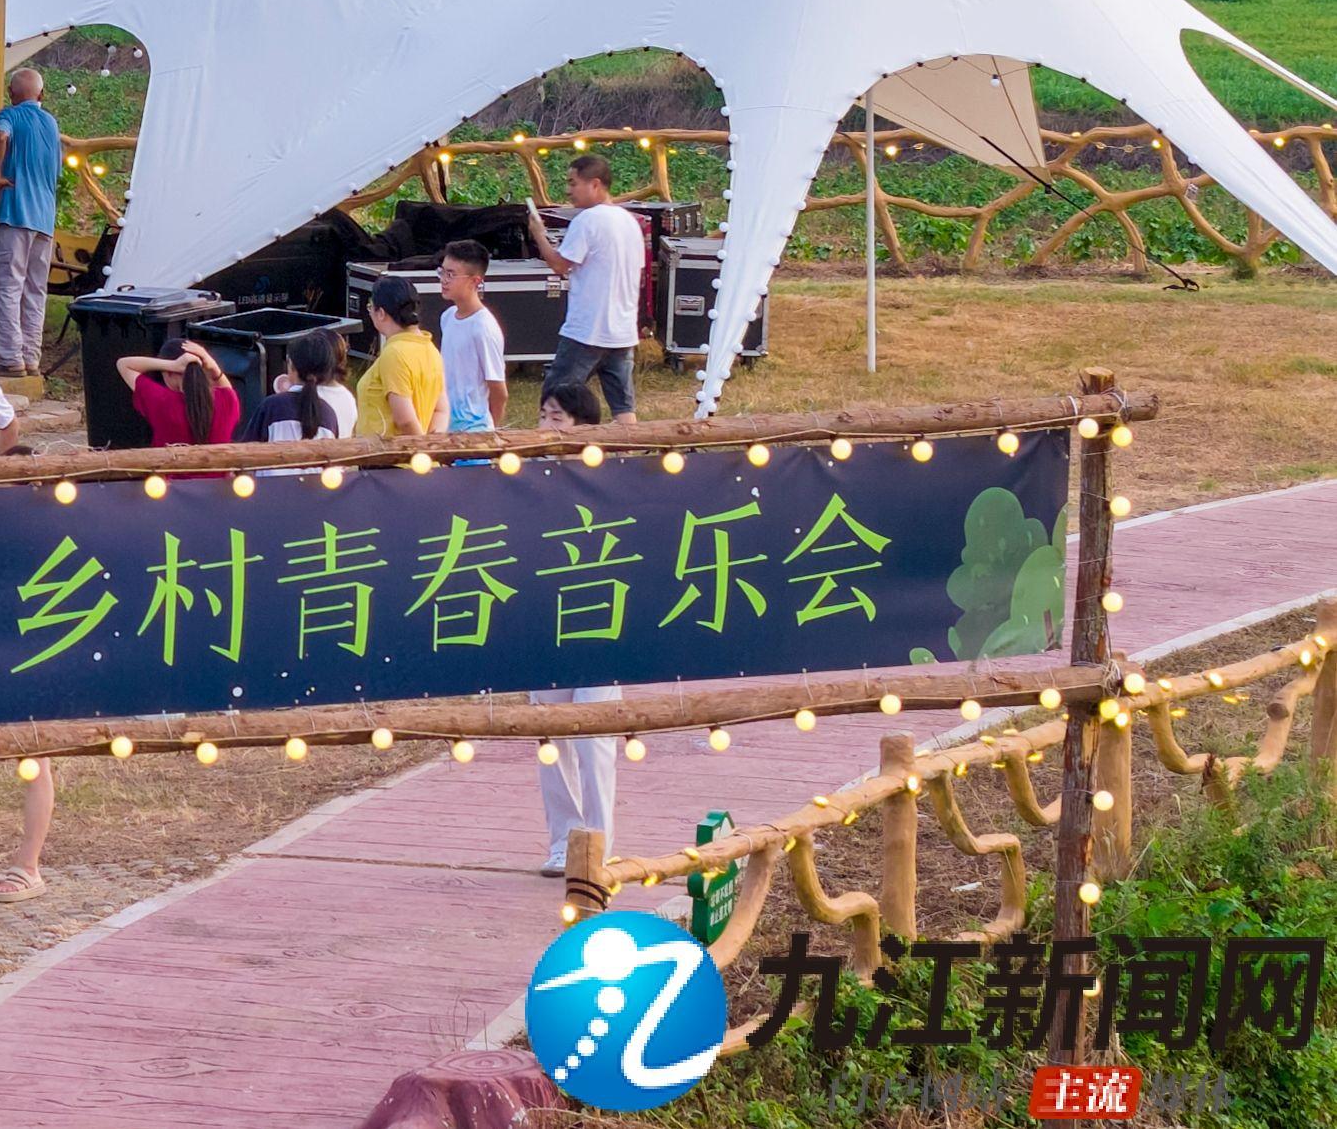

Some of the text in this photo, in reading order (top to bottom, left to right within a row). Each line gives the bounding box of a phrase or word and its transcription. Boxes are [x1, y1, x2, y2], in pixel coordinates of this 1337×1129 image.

[15, 494, 890, 671] 乡村青春音乐会
